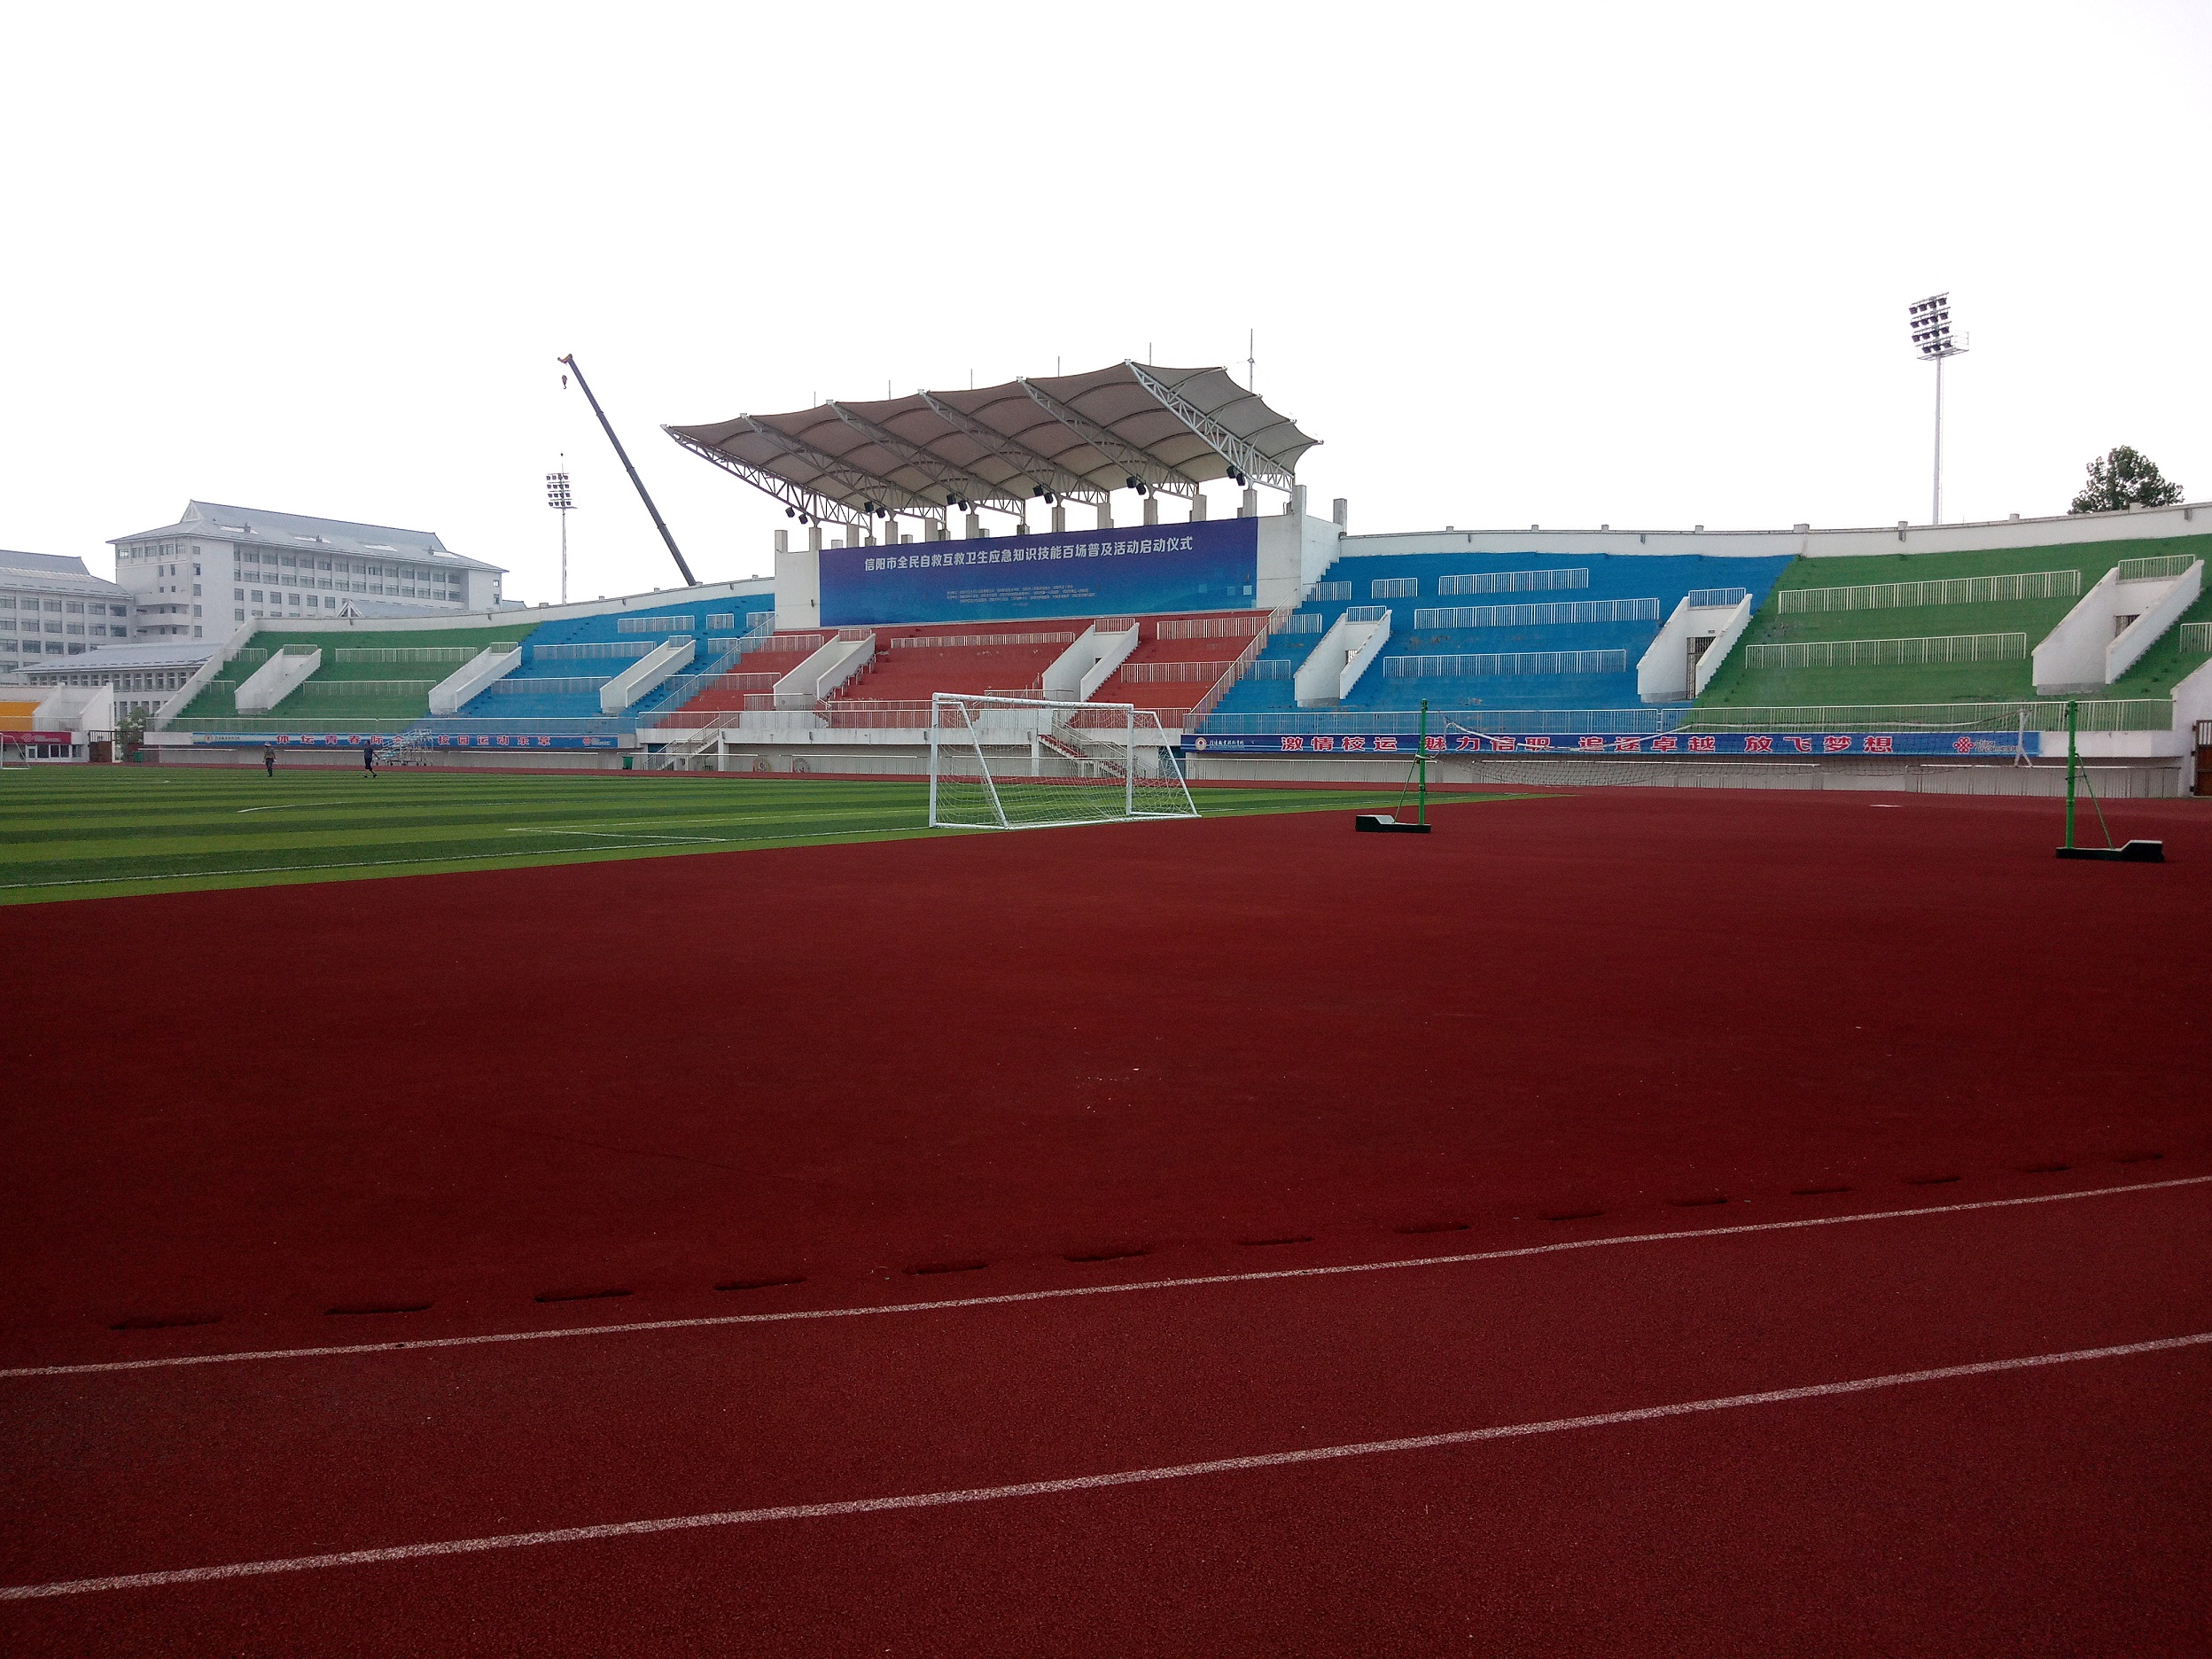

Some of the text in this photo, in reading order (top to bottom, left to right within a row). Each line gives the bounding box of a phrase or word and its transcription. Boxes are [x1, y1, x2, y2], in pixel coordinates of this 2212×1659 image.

[864, 536, 1193, 572] 信阳市全民自救互救卫生应急知识技能百场普及活动启动仪式
[438, 735, 550, 746] 校园运动乐章
[1281, 736, 1893, 752] 激情校运 魅力信职 追逐卓越 放飞梦想
